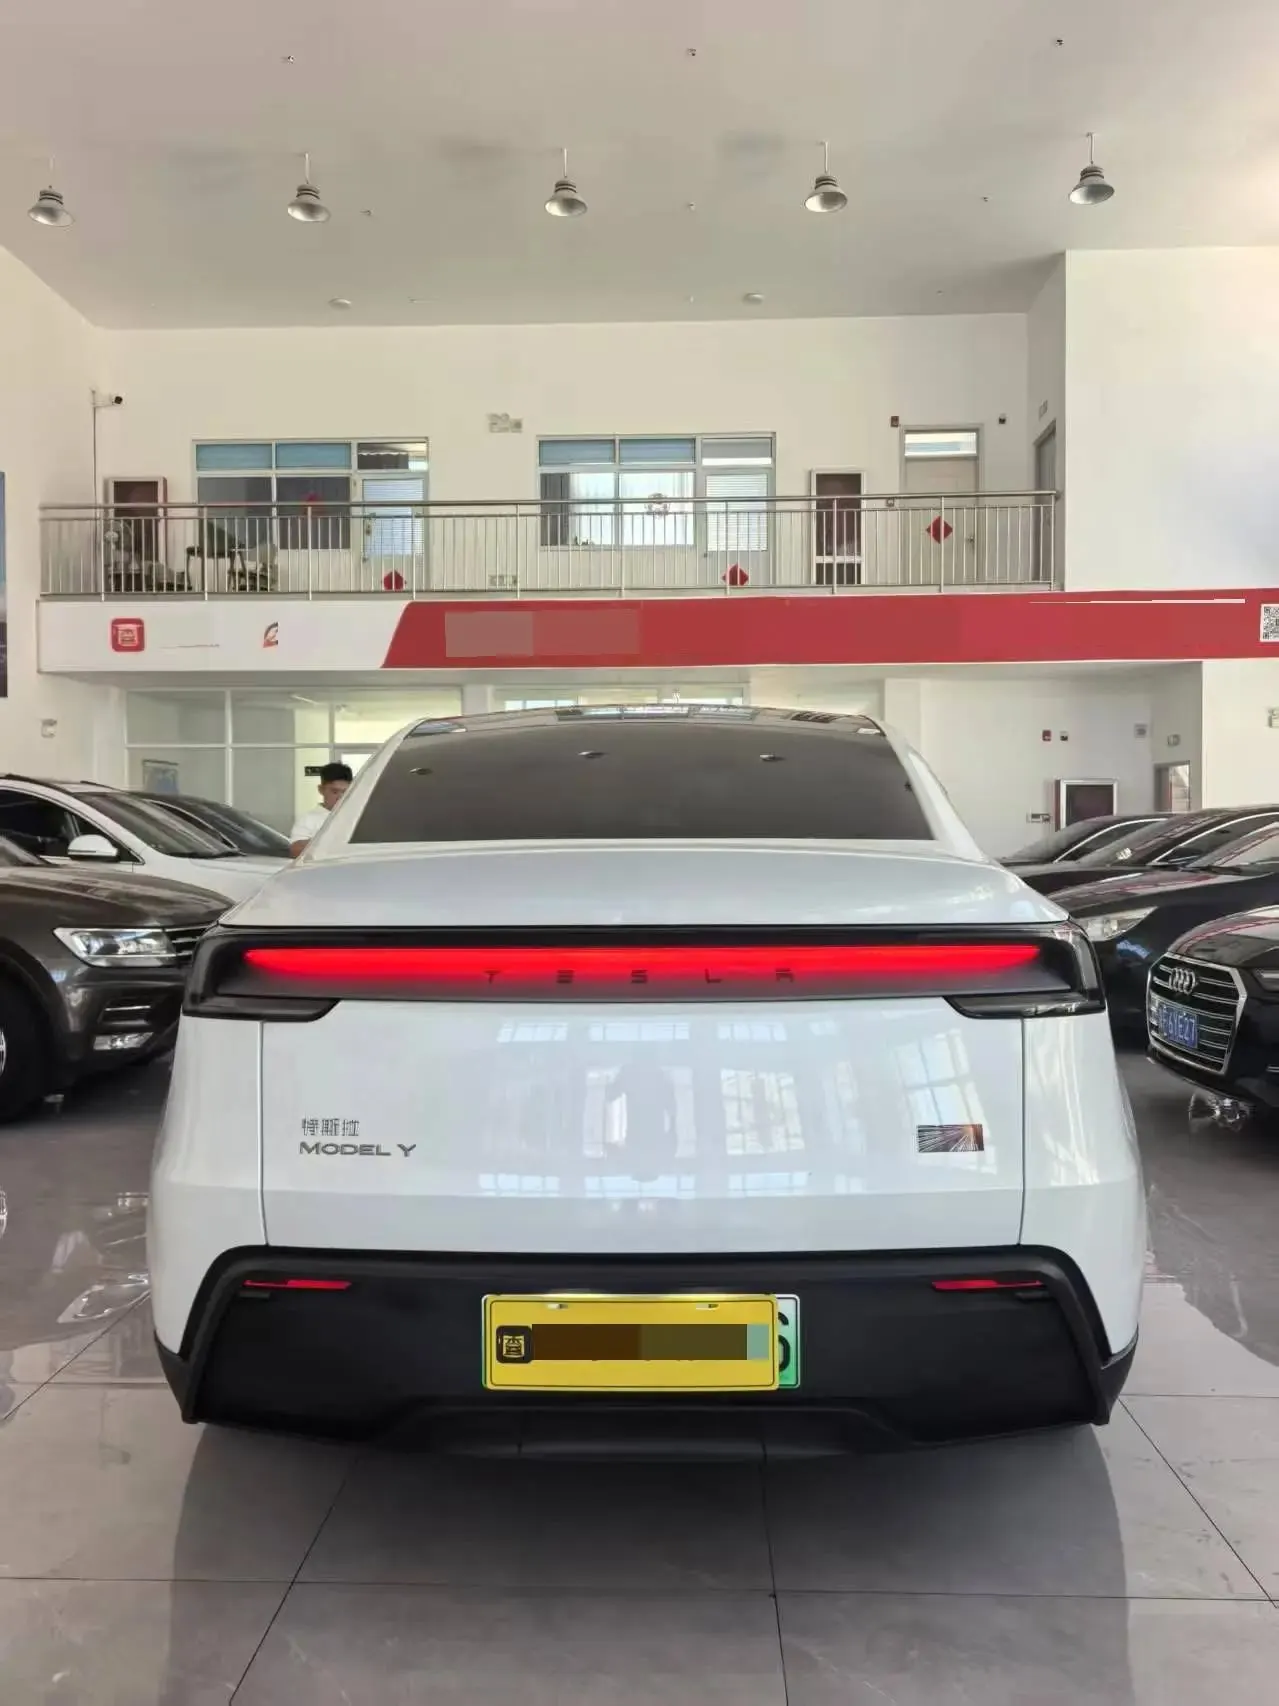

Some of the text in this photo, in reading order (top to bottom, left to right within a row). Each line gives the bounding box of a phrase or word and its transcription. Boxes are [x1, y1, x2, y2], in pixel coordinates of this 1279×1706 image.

[484, 967, 796, 984] TESLA
[301, 1118, 360, 1137] 特斯拉
[299, 1141, 417, 1157] MODEL Y
